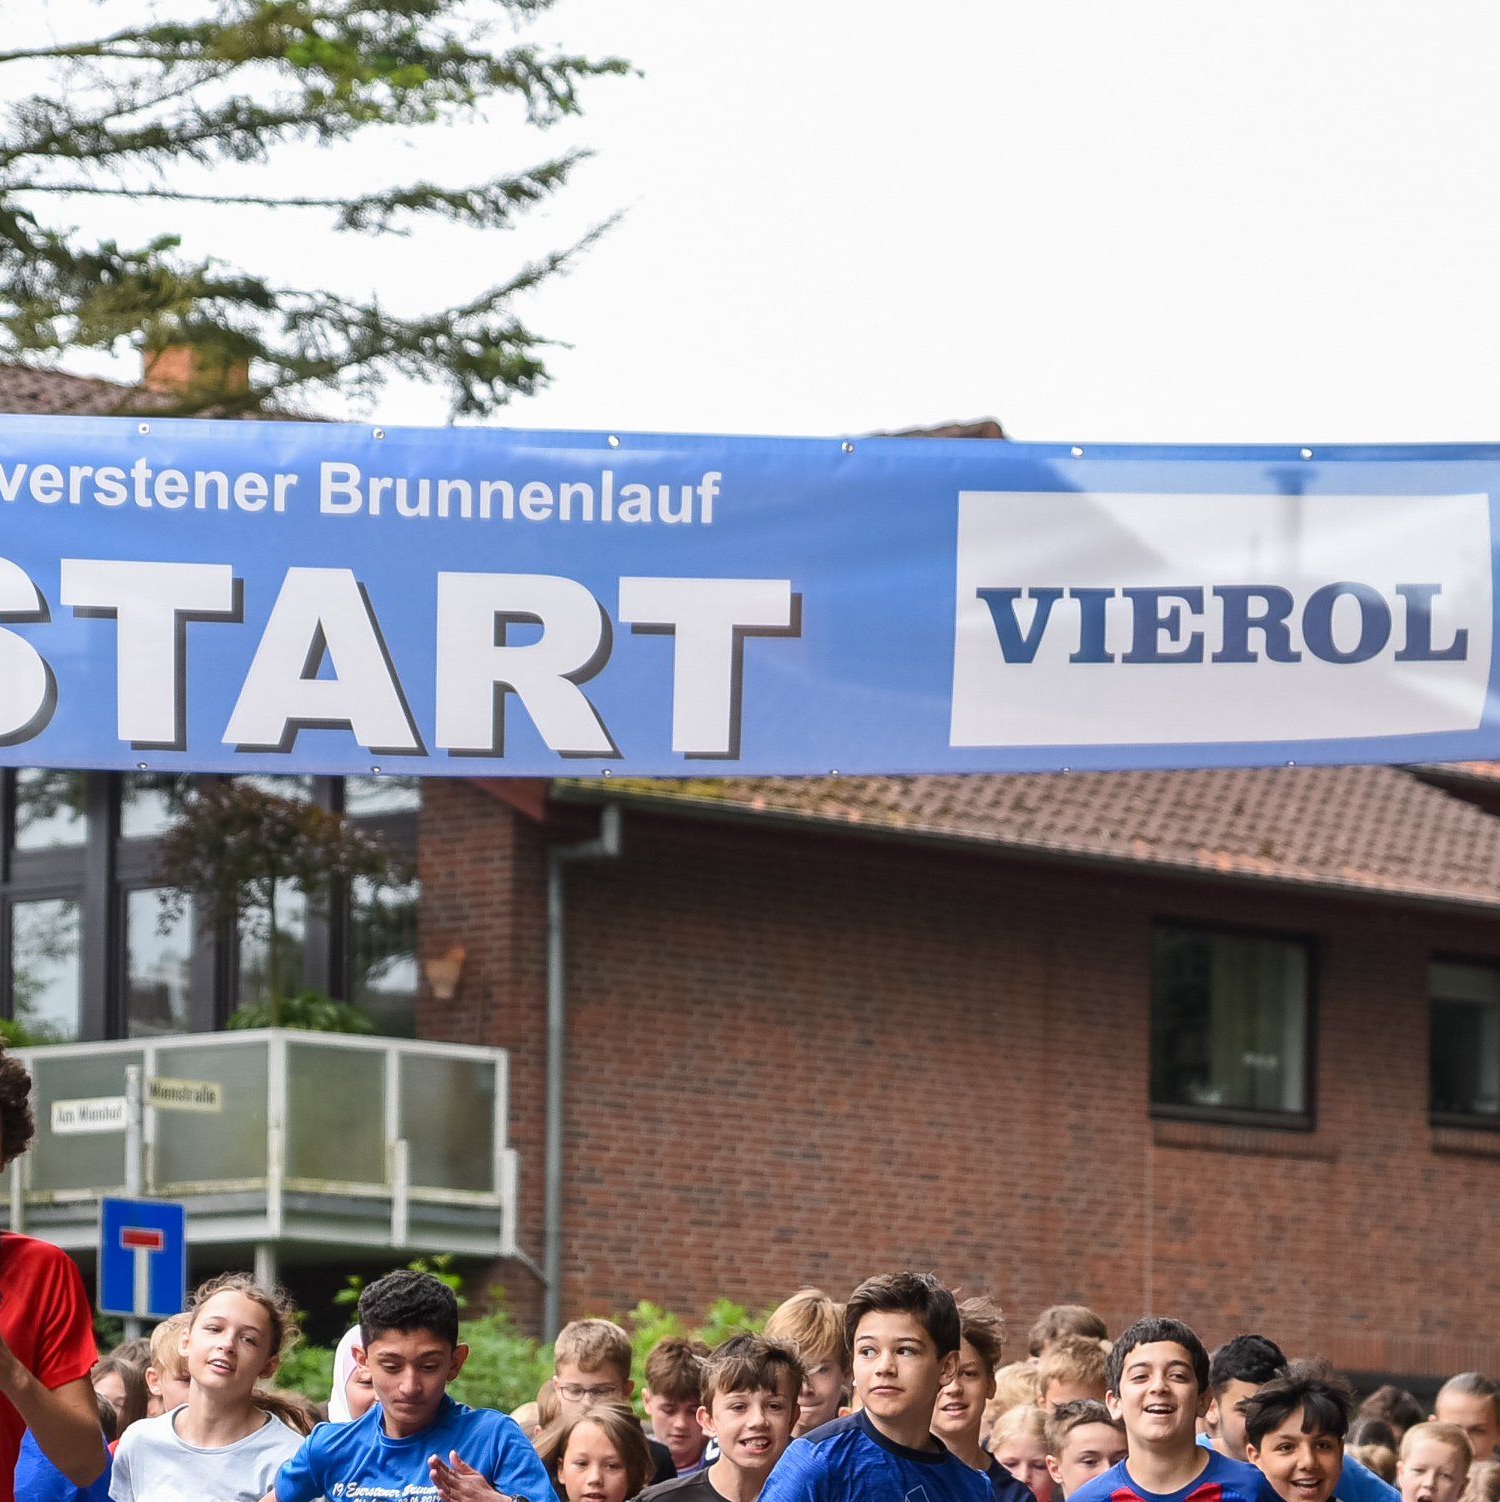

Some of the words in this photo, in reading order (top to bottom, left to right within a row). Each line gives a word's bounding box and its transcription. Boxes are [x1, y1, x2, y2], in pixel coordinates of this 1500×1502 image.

[318, 460, 721, 525] Brunnenlauf
[976, 581, 1469, 664] VIEROL
[346, 1481, 400, 1497] Everstener
